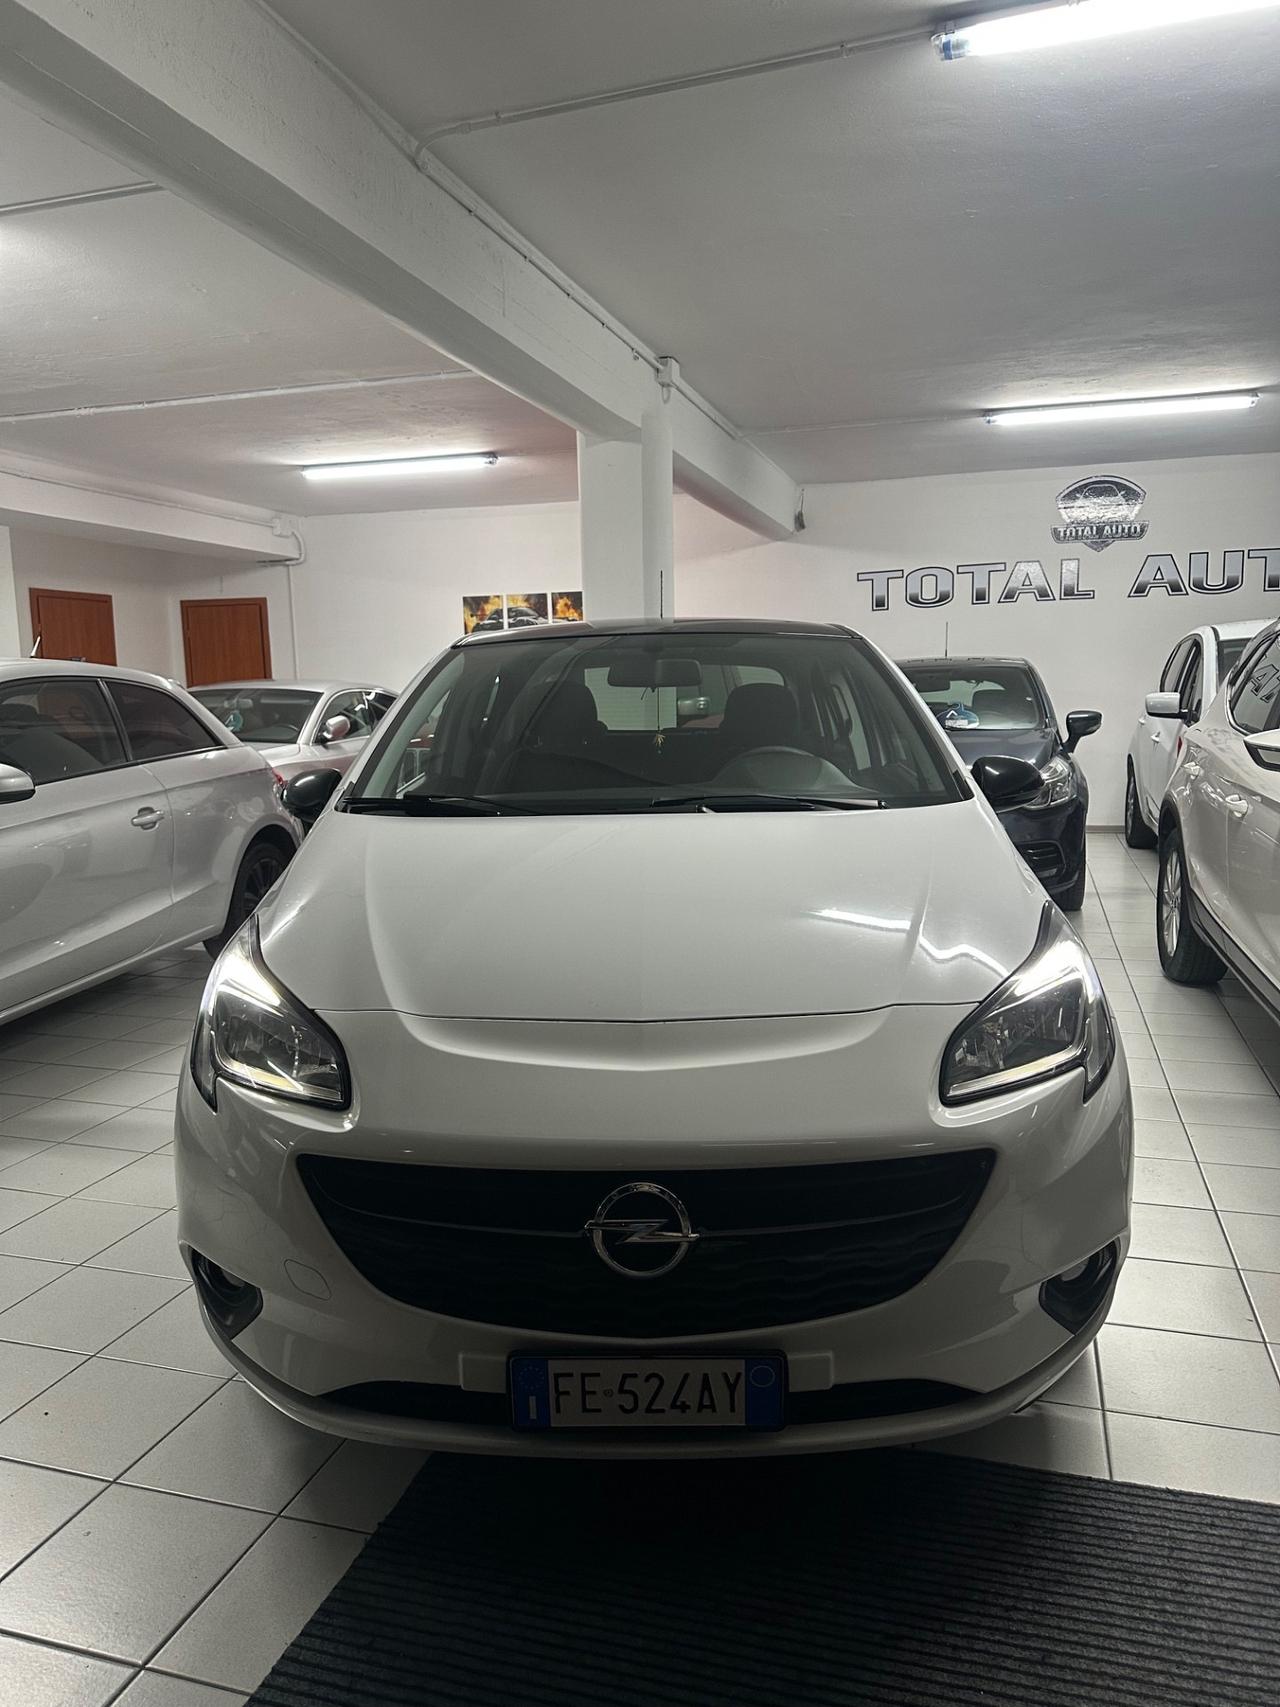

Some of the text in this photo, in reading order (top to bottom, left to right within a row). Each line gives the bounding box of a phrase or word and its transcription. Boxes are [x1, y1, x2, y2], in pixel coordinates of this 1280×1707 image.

[1057, 524, 1141, 539] TOTAL AUTO
[857, 558, 1096, 612] TOTAL
